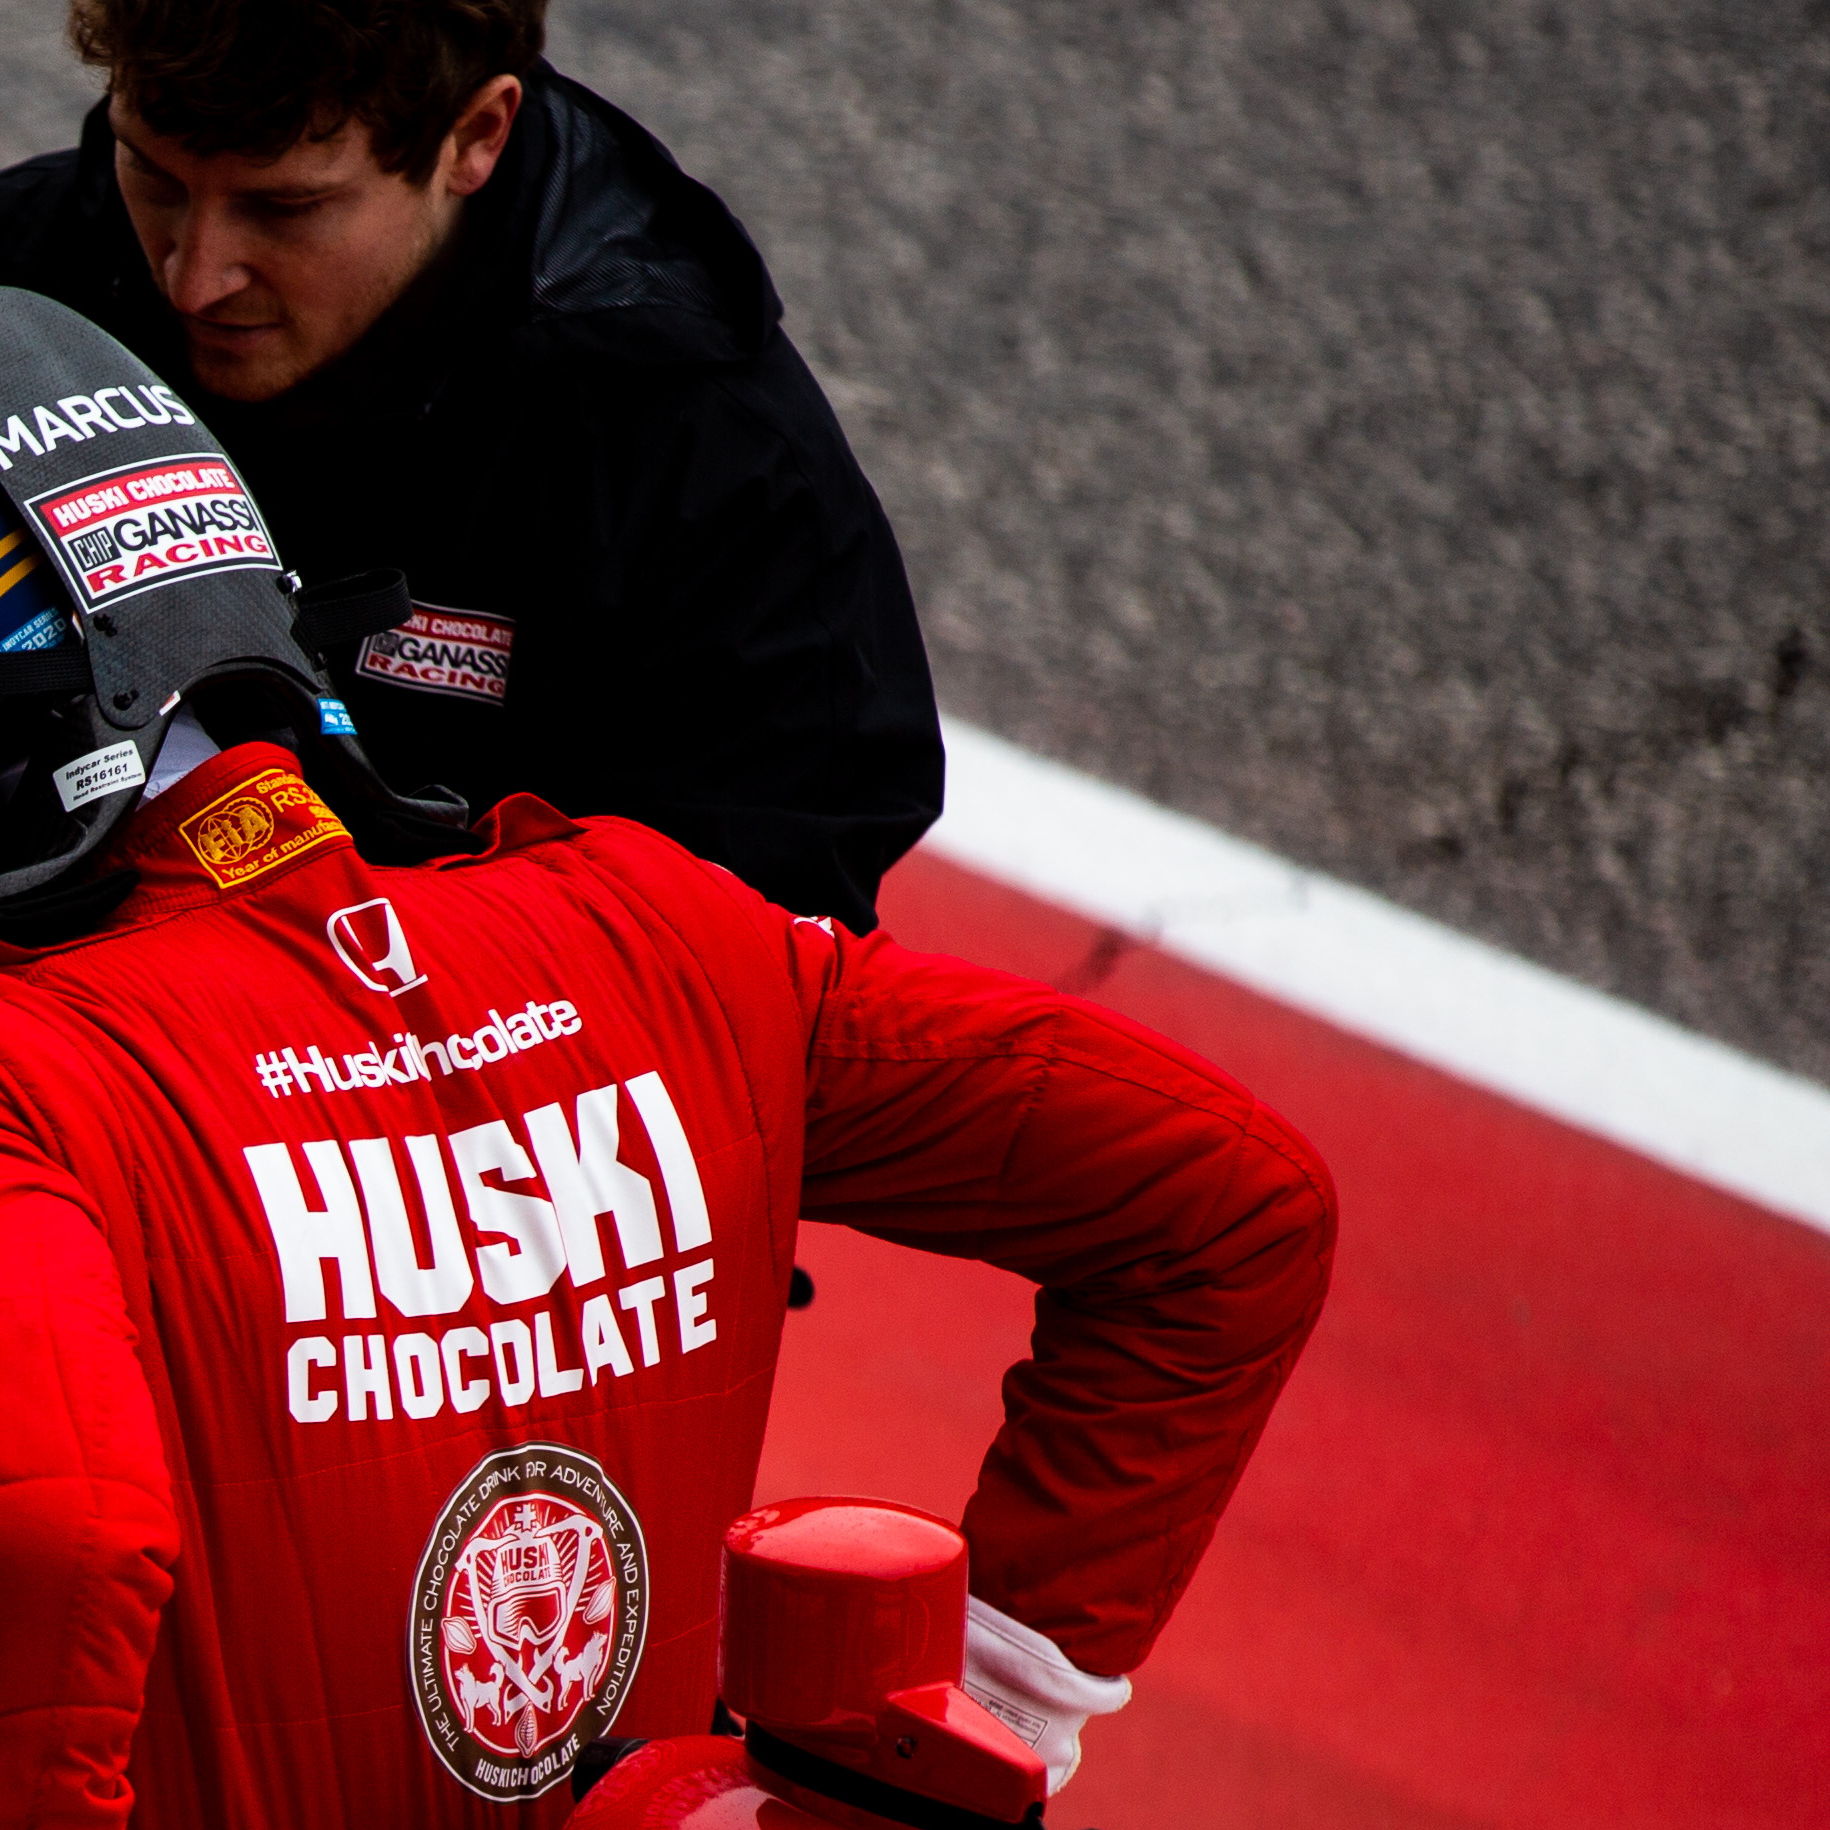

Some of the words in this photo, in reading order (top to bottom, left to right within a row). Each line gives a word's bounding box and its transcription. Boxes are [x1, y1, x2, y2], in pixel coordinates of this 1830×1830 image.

[51, 485, 130, 528] HUSKI
[126, 466, 236, 500] CHOCOLATE
[71, 527, 115, 569] CHIP
[112, 500, 259, 551] GANASSI
[86, 534, 269, 593] RACING
[367, 654, 506, 694] RACING
[397, 637, 509, 679] GANASS
[66, 757, 101, 780] Indycar
[104, 749, 134, 763] Series
[76, 763, 128, 791] RS16161
[222, 859, 260, 879] Year
[263, 847, 279, 862] of
[243, 1071, 713, 1324] HUSKI
[286, 1258, 717, 1424] CHOCOLATE
[478, 1465, 521, 1500] DRINK
[550, 1464, 625, 1540] ADVENTURE
[424, 1493, 481, 1611] CHOCOLATE
[617, 1542, 638, 1584] AND
[420, 1617, 443, 1711] ULTIMATE
[596, 1588, 640, 1716] EXPEDITION
[433, 1711, 459, 1752] THE
